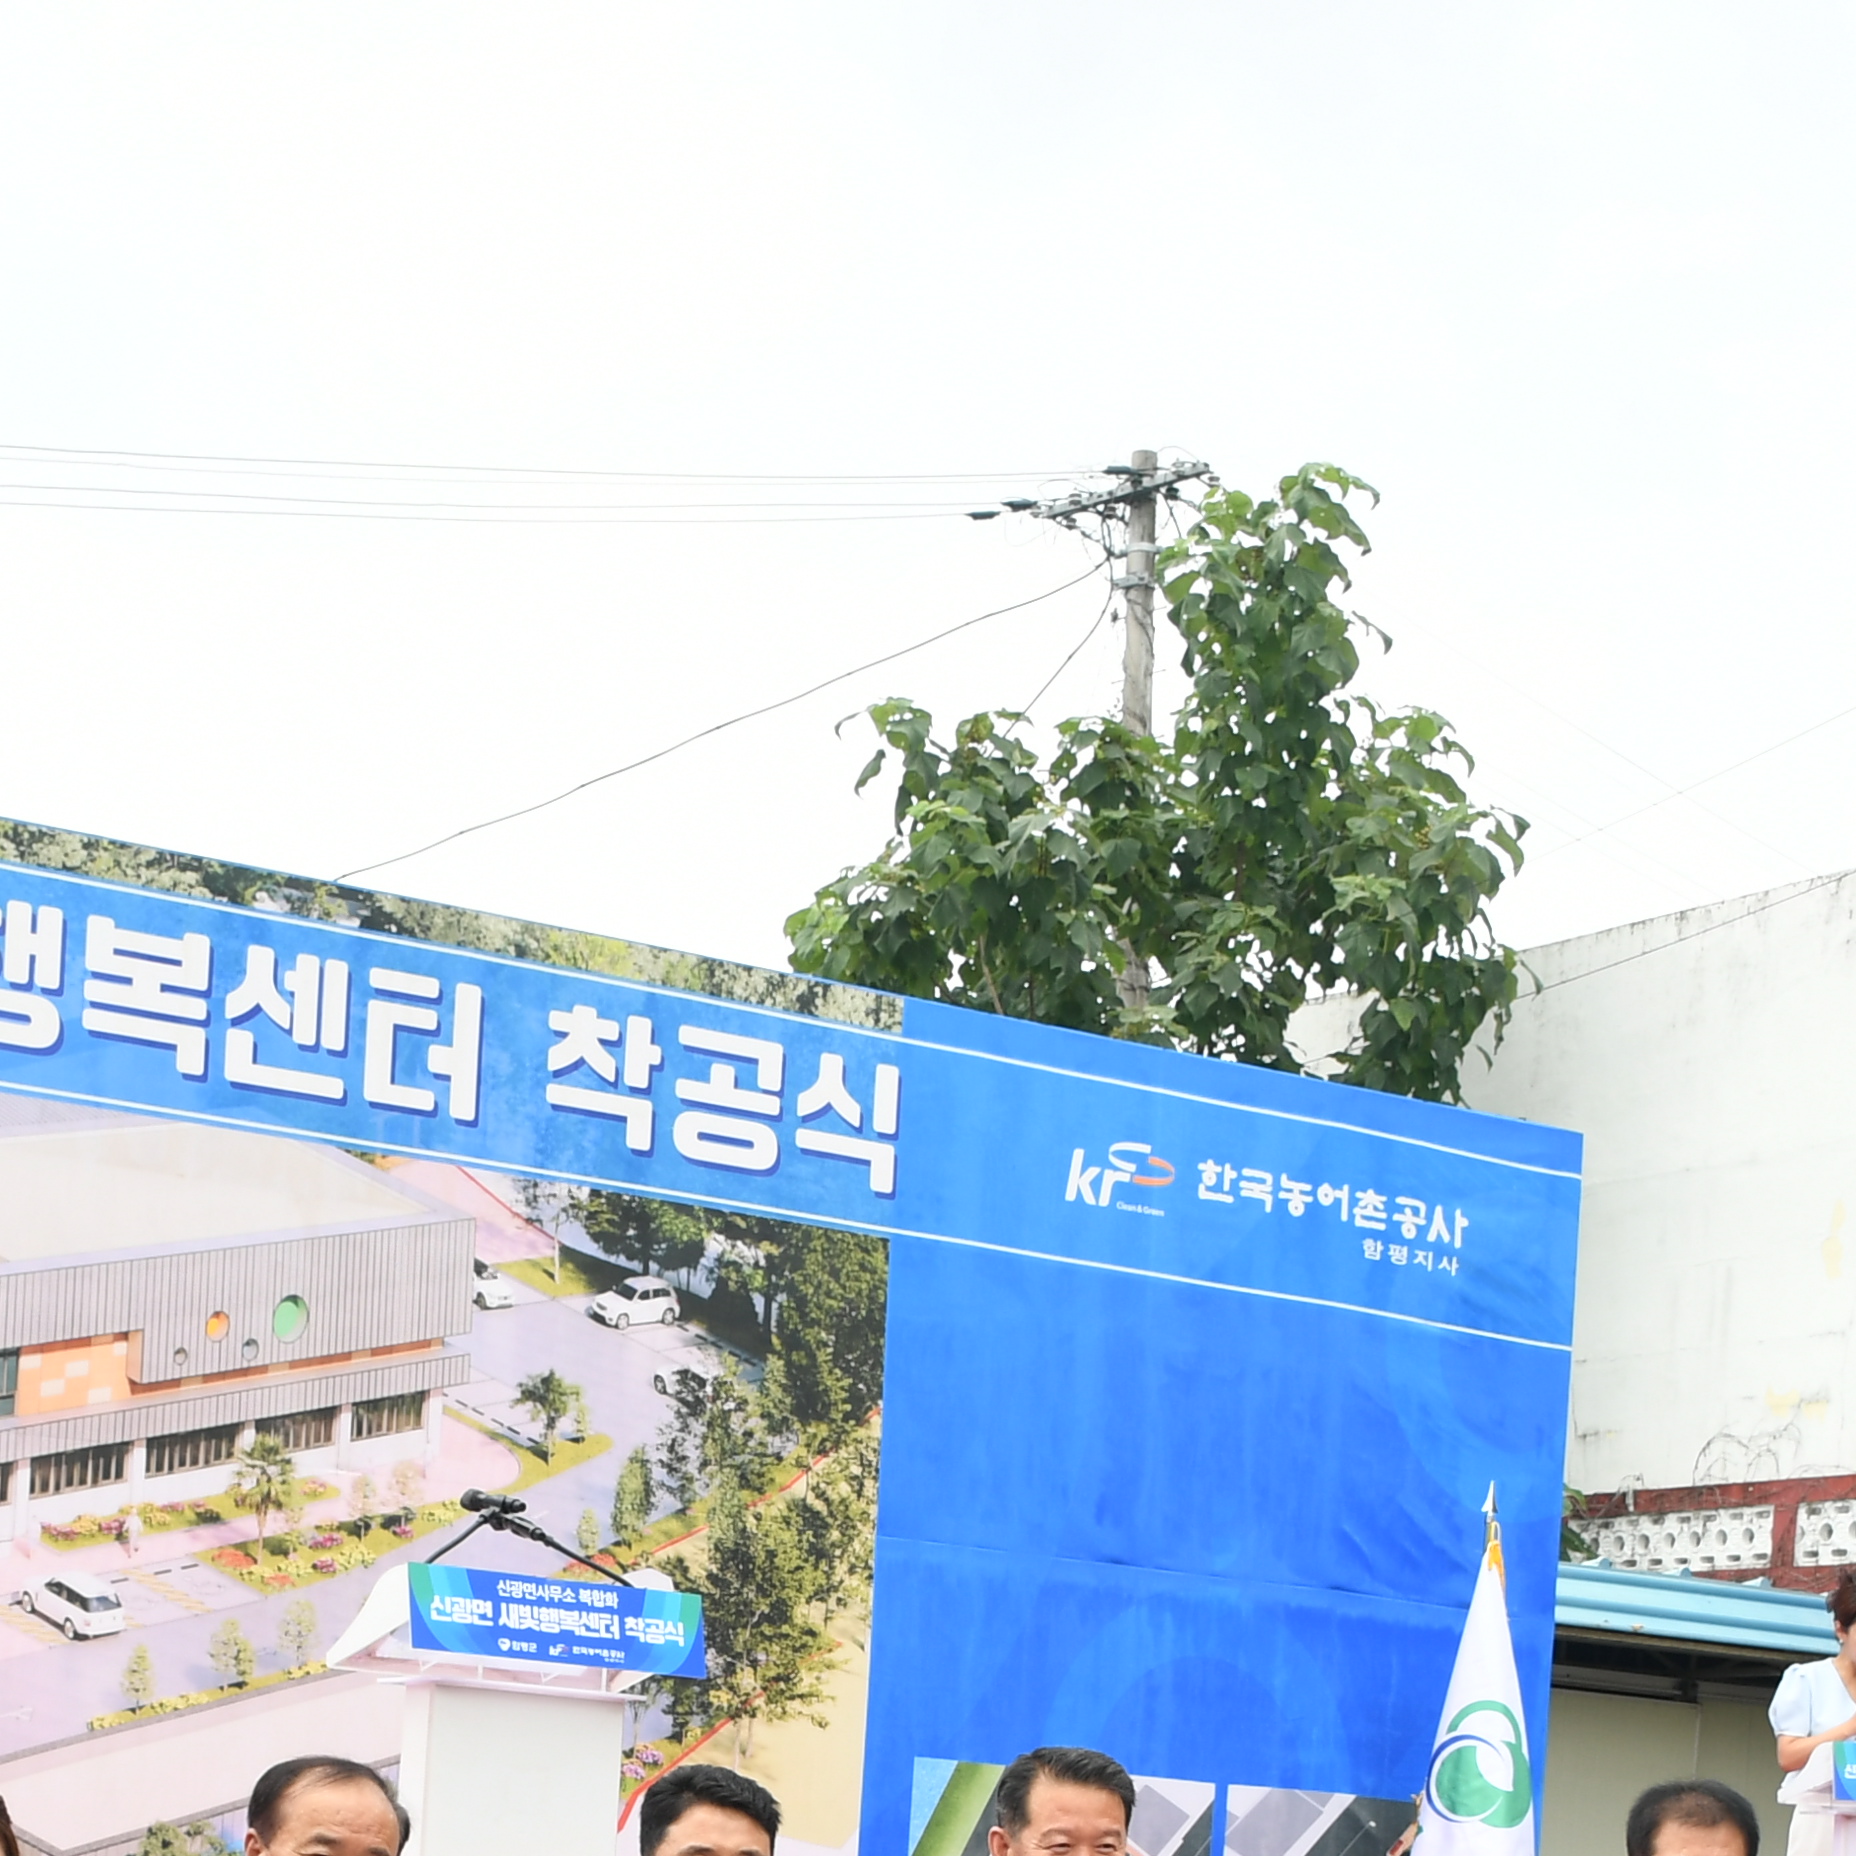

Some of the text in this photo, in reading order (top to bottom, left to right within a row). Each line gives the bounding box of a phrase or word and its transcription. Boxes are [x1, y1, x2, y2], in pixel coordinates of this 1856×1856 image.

[546, 1003, 902, 1196] 착공식
[1197, 1159, 1469, 1249] 한국농어촌공사
[1362, 1238, 1459, 1277] 함평지사
[497, 1579, 619, 1609] 신광면사무소 복합화
[430, 1595, 685, 1647] 신광면 새빛행복센터 착공식
